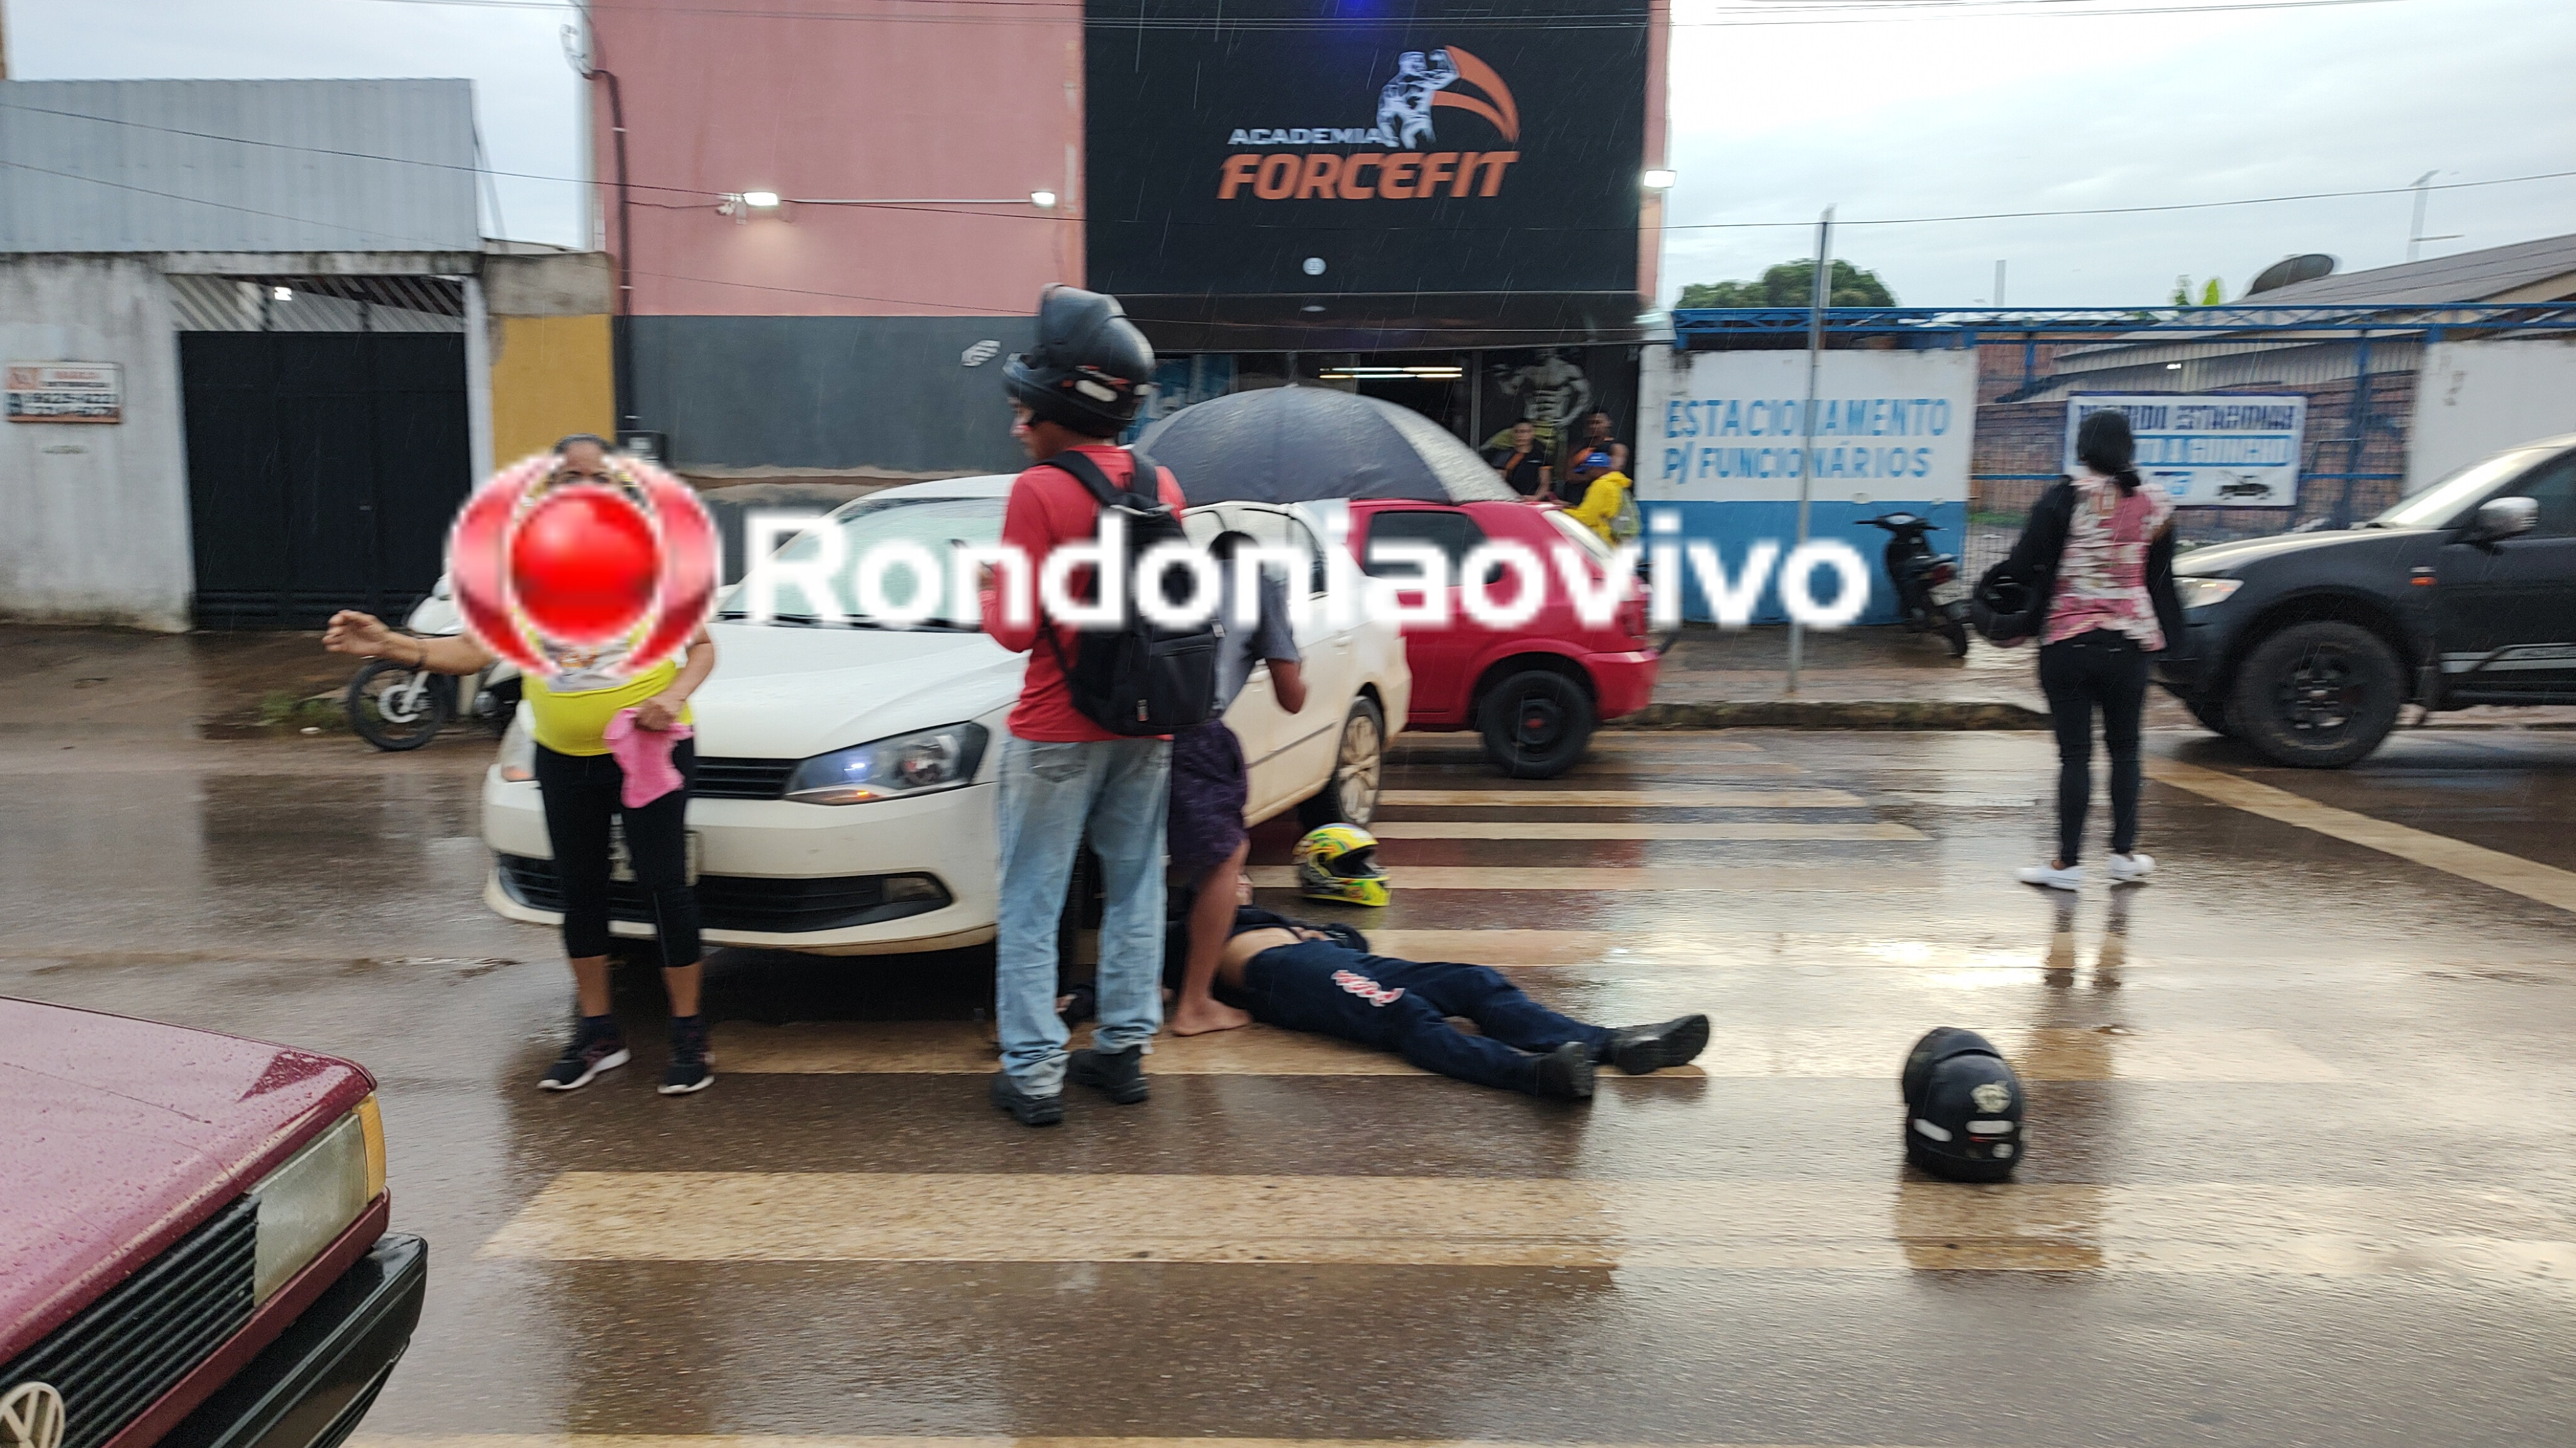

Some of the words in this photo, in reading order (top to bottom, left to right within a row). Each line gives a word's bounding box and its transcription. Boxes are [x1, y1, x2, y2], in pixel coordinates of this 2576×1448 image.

[1227, 128, 1385, 145] ACADEMIA
[1217, 151, 1520, 199] FORCEFIT
[1664, 399, 1951, 437] ESTACIONAMENTO
